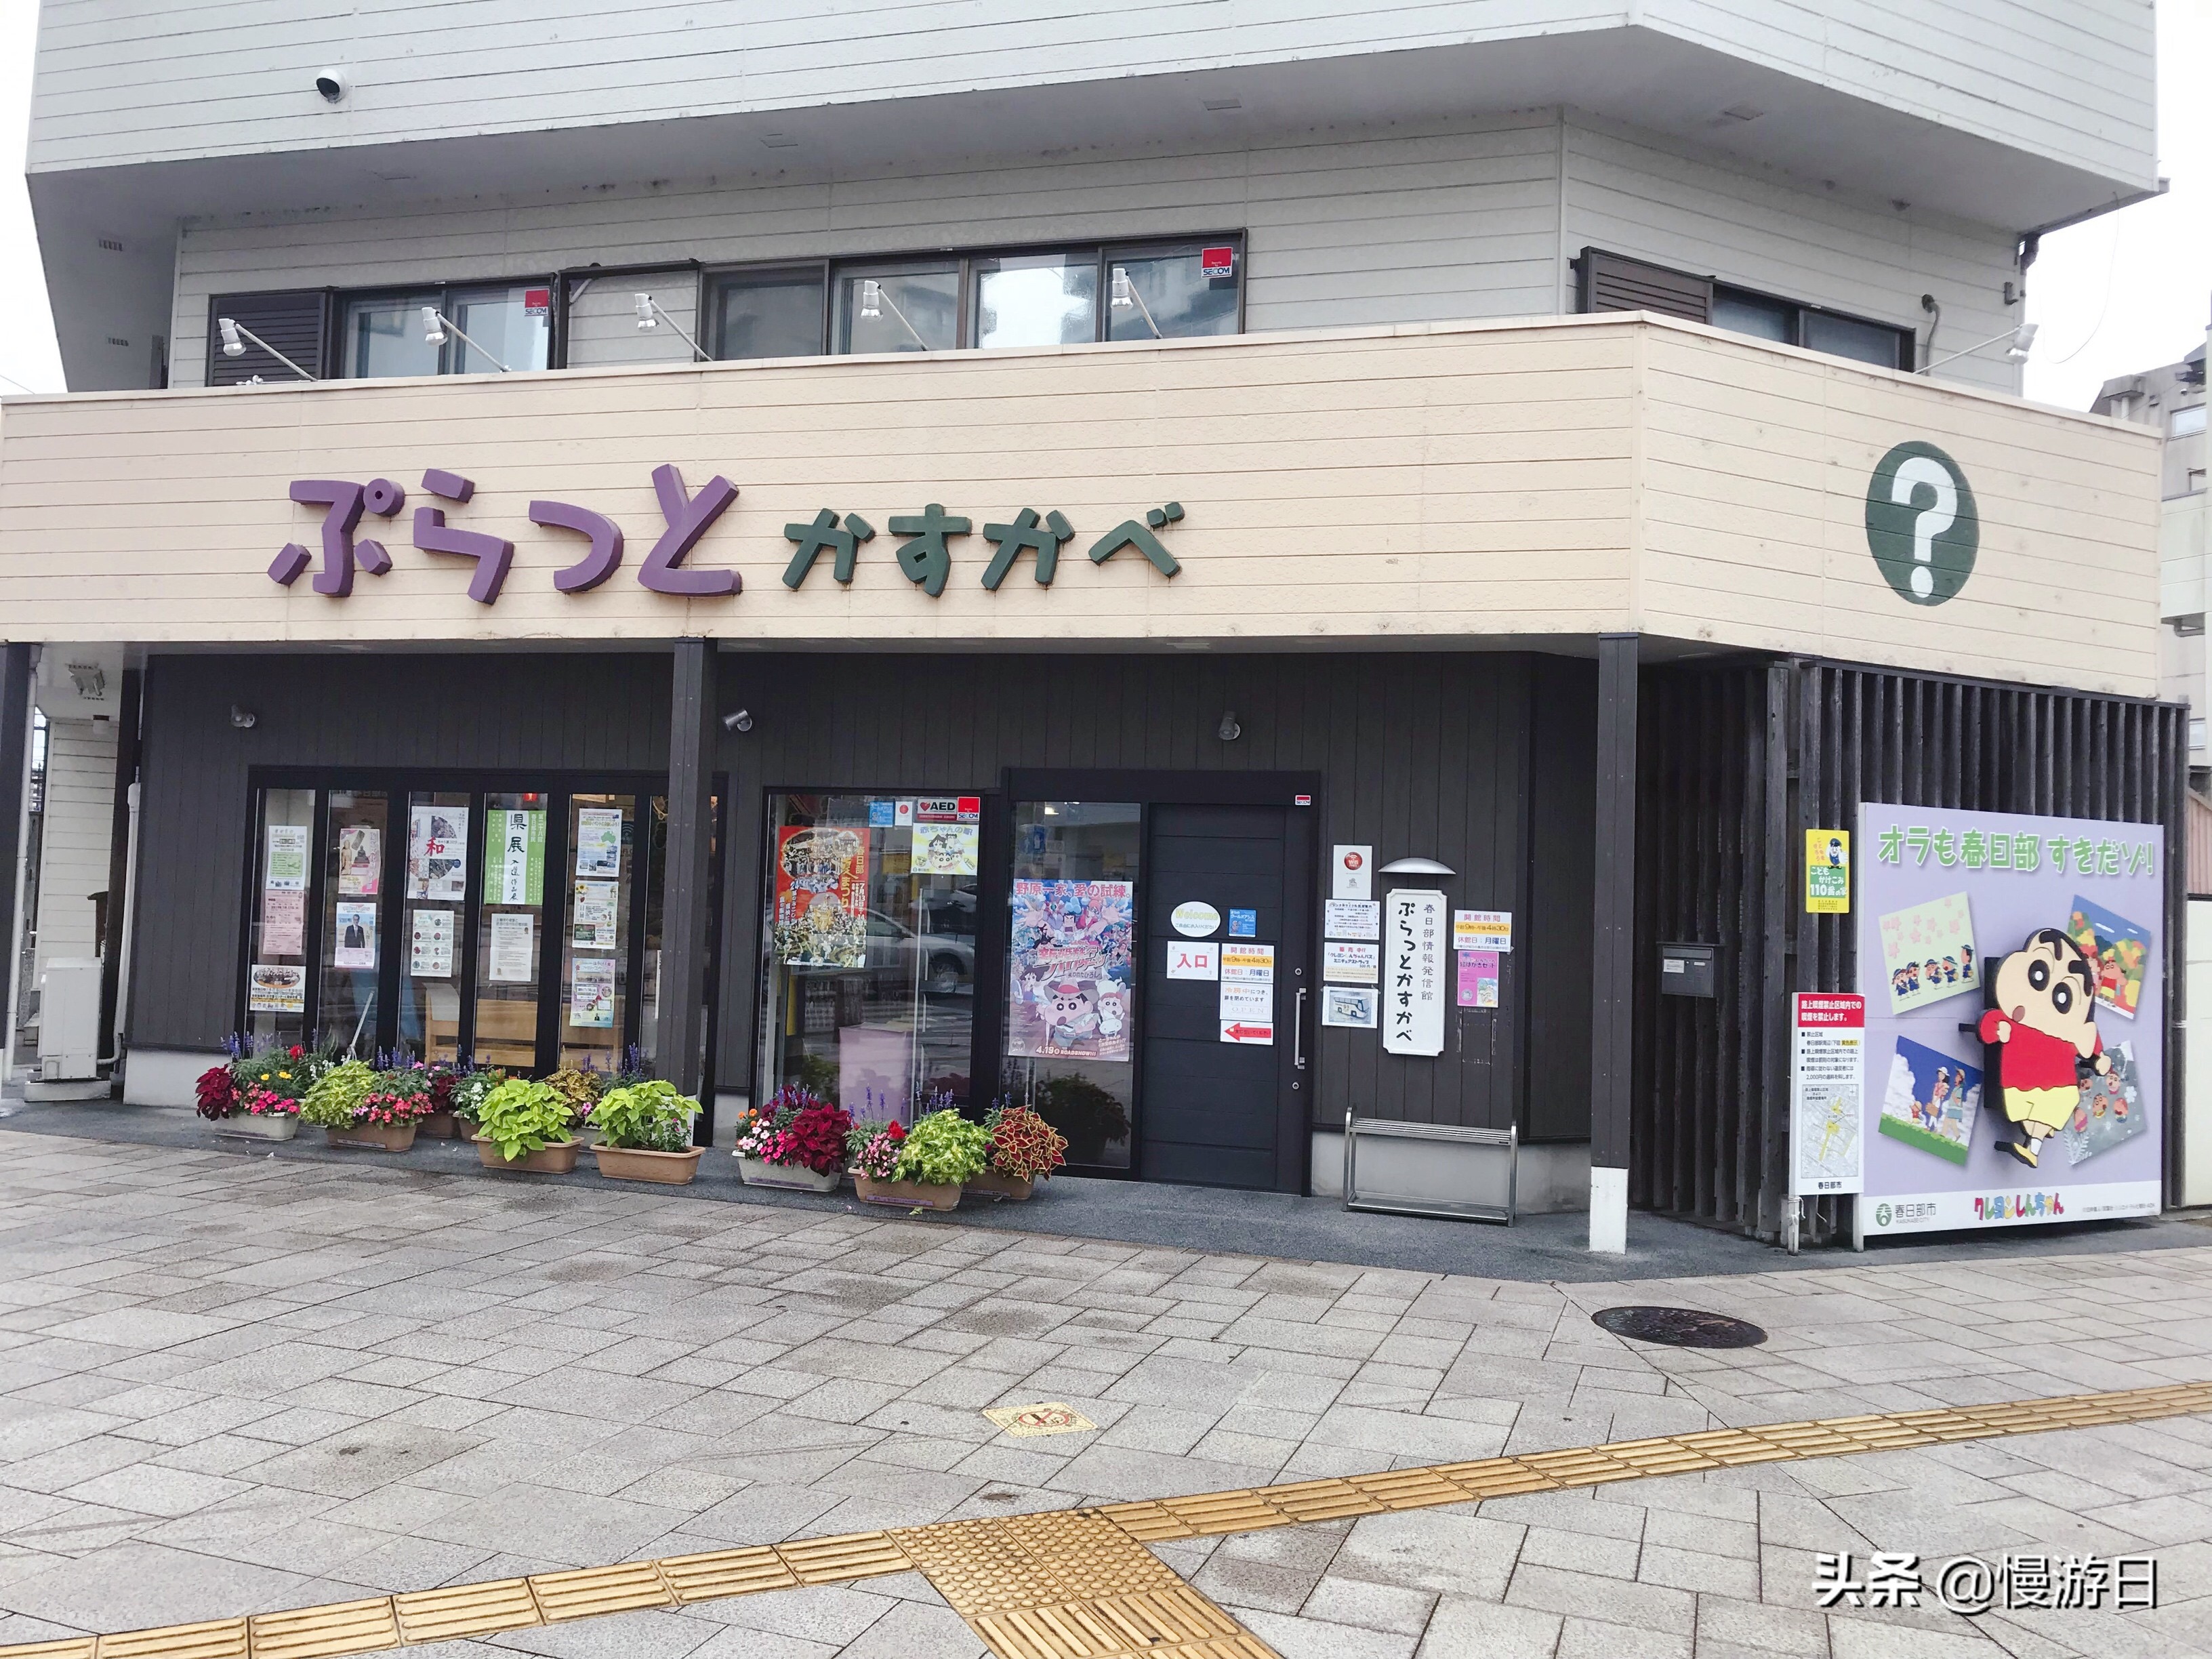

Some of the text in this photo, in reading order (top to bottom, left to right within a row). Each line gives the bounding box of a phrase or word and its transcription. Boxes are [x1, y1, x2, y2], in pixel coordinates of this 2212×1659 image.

[1204, 267, 1230, 275] SECOM
[267, 464, 1186, 605] ぷらっと かすかべ
[930, 802, 956, 811] AED
[507, 813, 527, 853] 県展
[920, 825, 973, 836] 赤ちゃんの駅
[424, 836, 445, 857] 和
[1878, 823, 2041, 872] オラも春日部
[855, 846, 865, 874] 春日部
[1810, 867, 1830, 876] こども
[1818, 876, 1845, 884] かけこみ
[1016, 882, 1131, 898] 野原一家、愛の試練。
[1810, 884, 1847, 896] 110番の家
[1176, 908, 1218, 921] Welcome
[1464, 914, 1501, 922] 開館時間
[1230, 947, 1265, 956] 開館時間
[1420, 903, 1435, 1002] 春日部情報発信館
[1176, 953, 1208, 968] 入口
[1395, 902, 1416, 1042] ぷらっとかすかべ
[1801, 1000, 1862, 1010] 路上喫煙禁止区域内での
[1801, 1012, 1847, 1021] 喫煙を禁止します。
[1818, 1181, 1843, 1189] 春日部市
[1895, 1203, 1937, 1218] 春日部市
[1974, 1191, 2065, 1221] クレヨンしんちゃん
